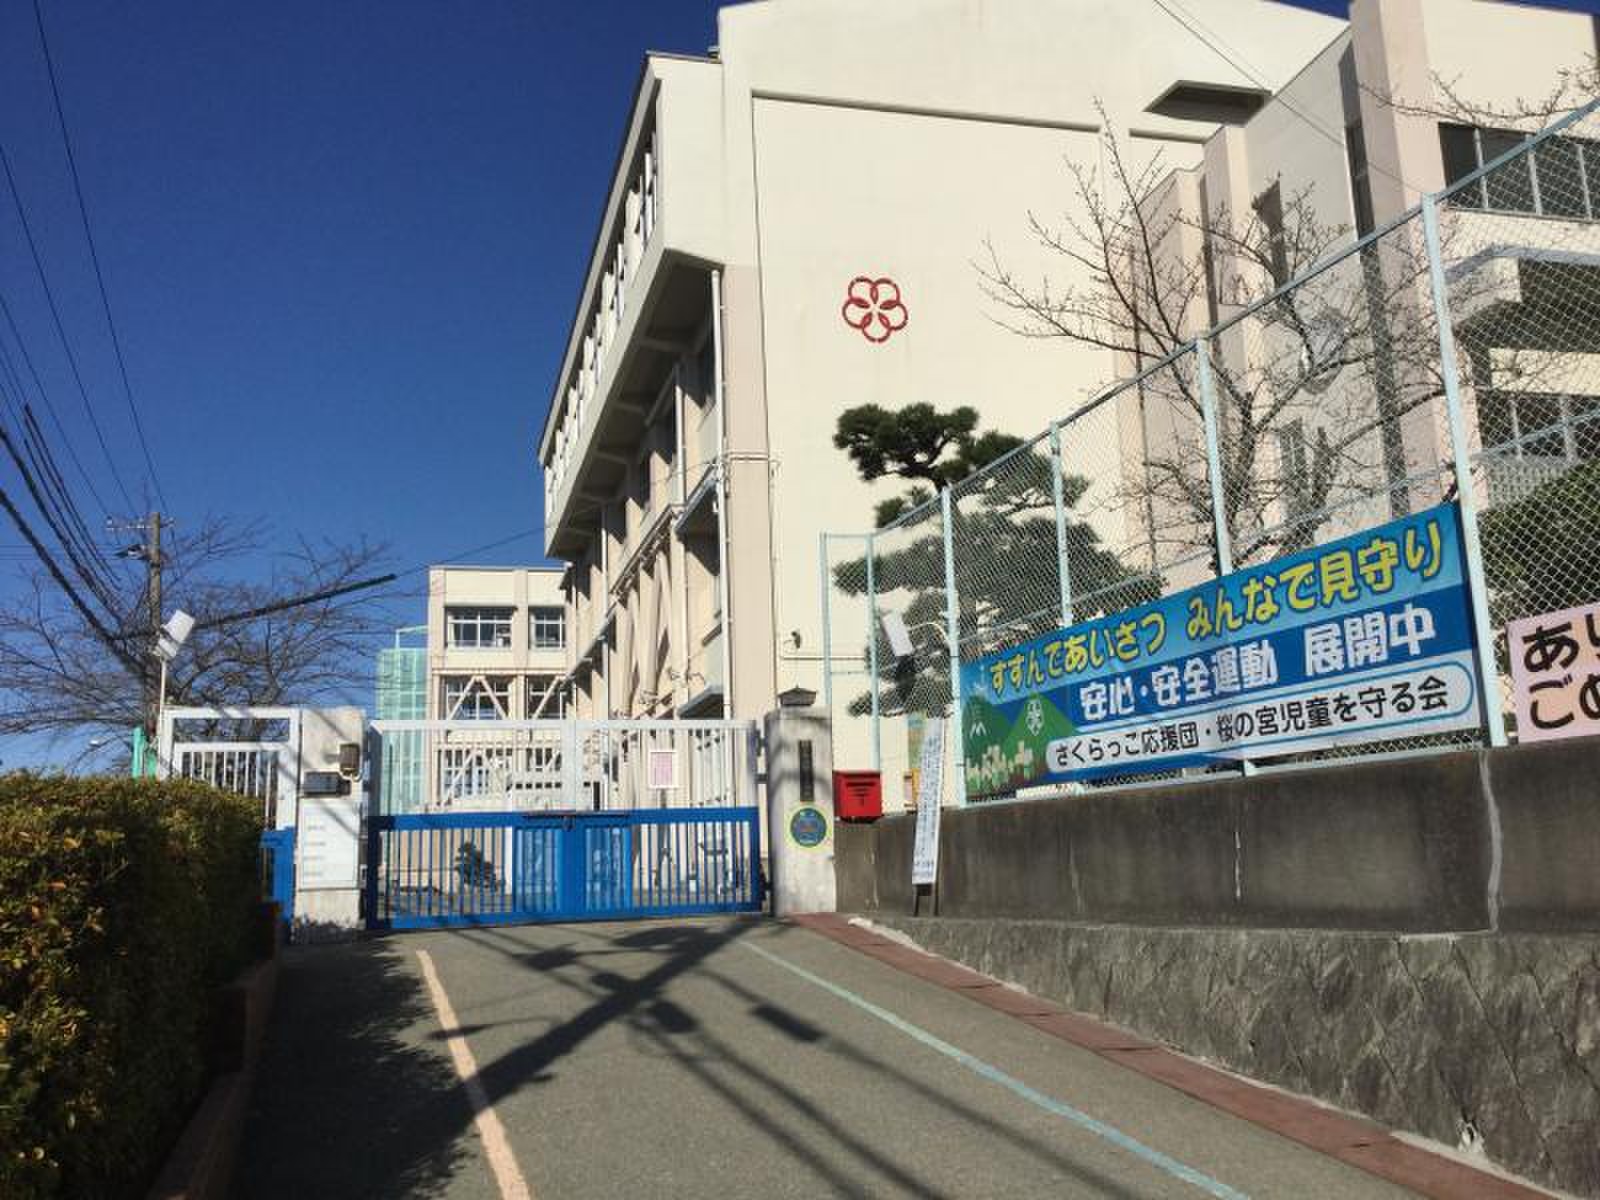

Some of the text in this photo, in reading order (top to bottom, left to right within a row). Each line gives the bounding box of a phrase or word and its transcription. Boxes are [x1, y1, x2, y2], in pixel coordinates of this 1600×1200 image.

[990, 520, 1442, 694] すすんであいさつ みんなで見守り
[1080, 603, 1436, 720] 安心・安全運動 展開中
